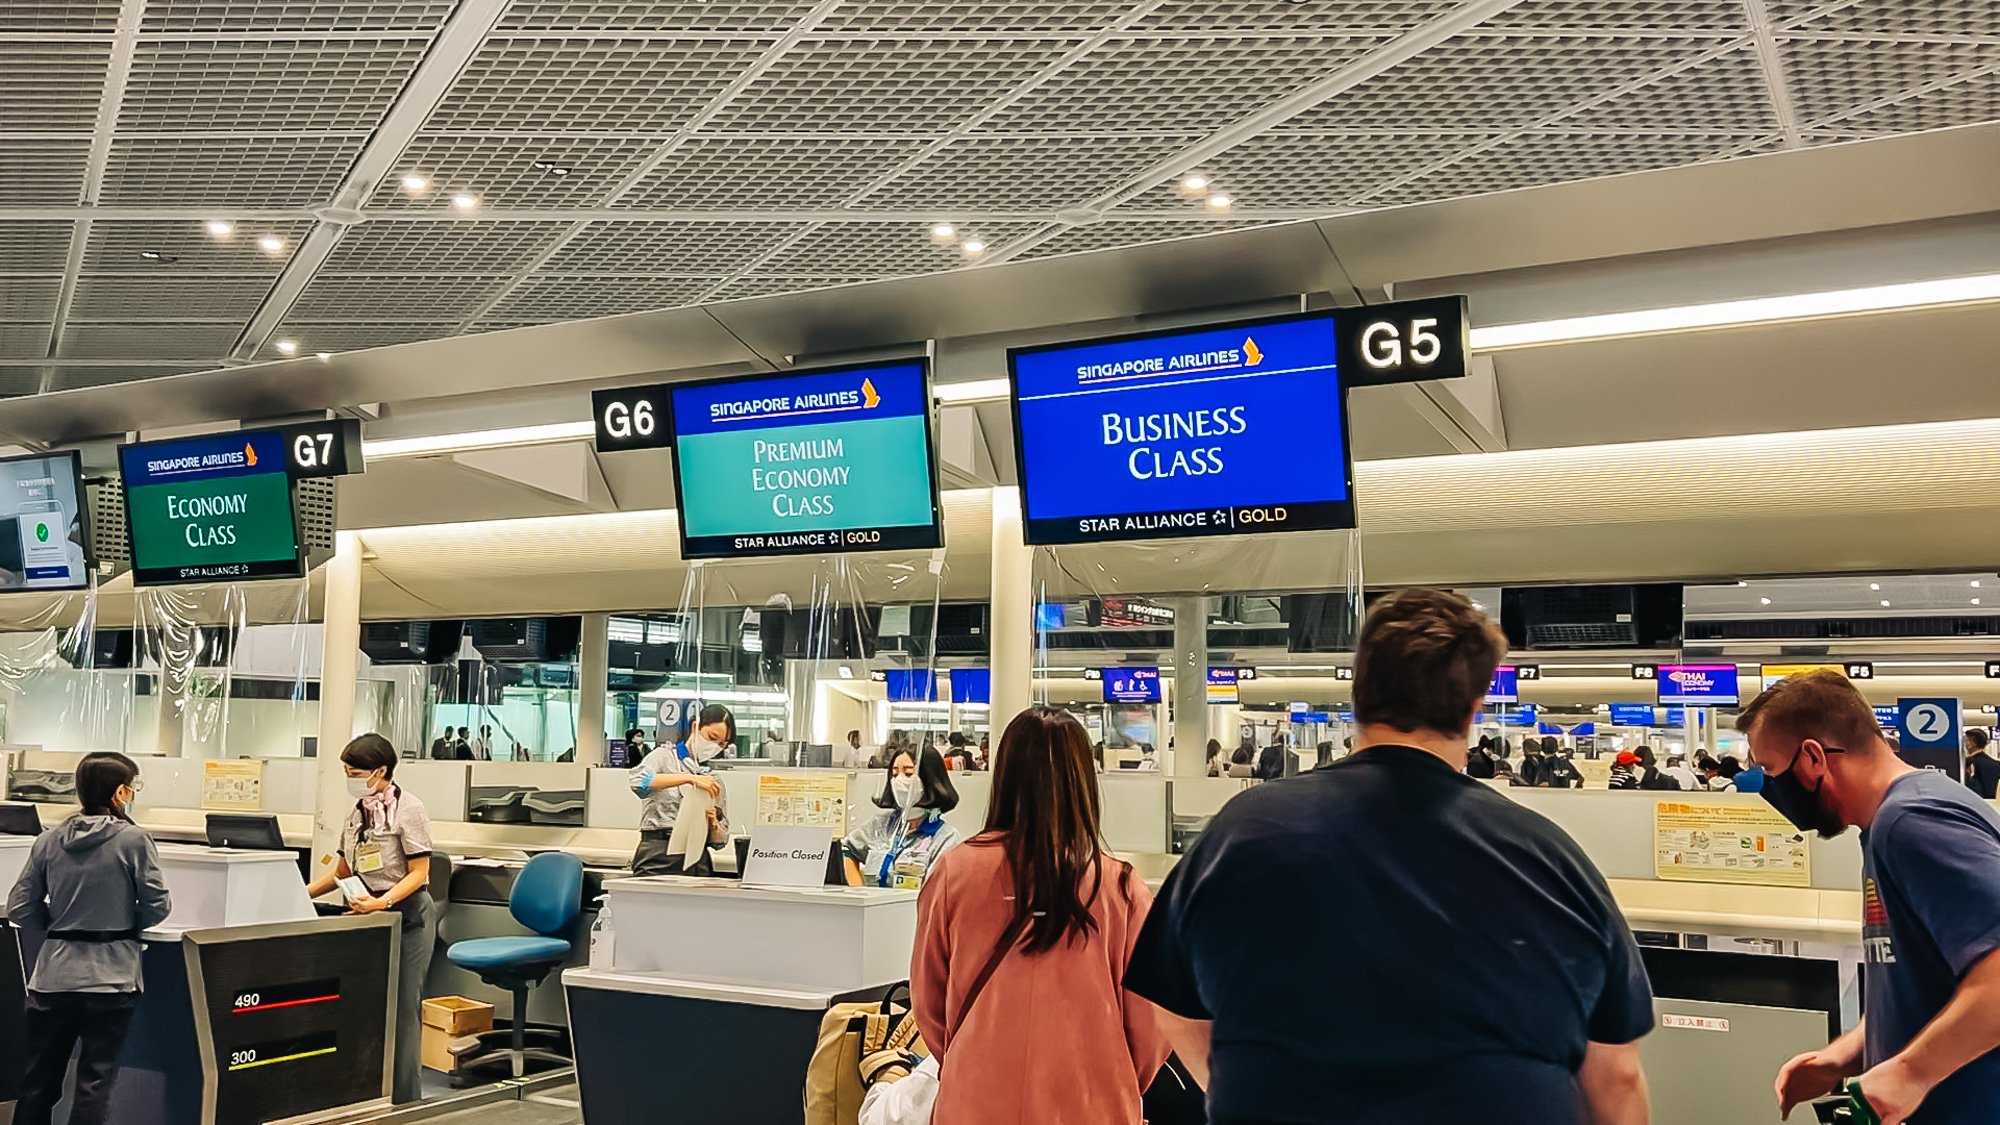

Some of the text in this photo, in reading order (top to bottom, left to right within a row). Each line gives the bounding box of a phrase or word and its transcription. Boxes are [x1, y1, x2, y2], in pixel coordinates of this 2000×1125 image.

[1361, 318, 1440, 369] G5
[1077, 349, 1239, 380] SINGAPORE AIRLINES
[710, 390, 859, 417] SINGAPORE AIRLINES
[604, 400, 655, 438] G6
[1102, 406, 1247, 446] BUSINESS
[148, 452, 244, 472] SINGAPORE AIRLINES
[294, 433, 333, 467] G7
[753, 438, 844, 464] PREMIUM
[1128, 446, 1224, 480] CLASS
[752, 466, 850, 492] ECONOMY
[167, 493, 248, 519] ECONOMY
[772, 494, 834, 518] CLASS
[1079, 508, 1287, 533] STAR ALLIANCE GOLD
[185, 523, 236, 547] CLASS
[735, 531, 880, 549] STAR ALLIANCE GOLD
[180, 565, 240, 578] STAR ALLIANCE
[1238, 669, 1254, 679] F9
[1519, 668, 1536, 678] F7
[1682, 672, 1706, 680] THAI
[1849, 665, 1870, 677] F5
[1989, 665, 2000, 677] F
[1918, 709, 1938, 735] 2
[752, 848, 825, 860] Position Closed
[234, 993, 260, 1008] 490
[231, 1049, 256, 1065] 300
